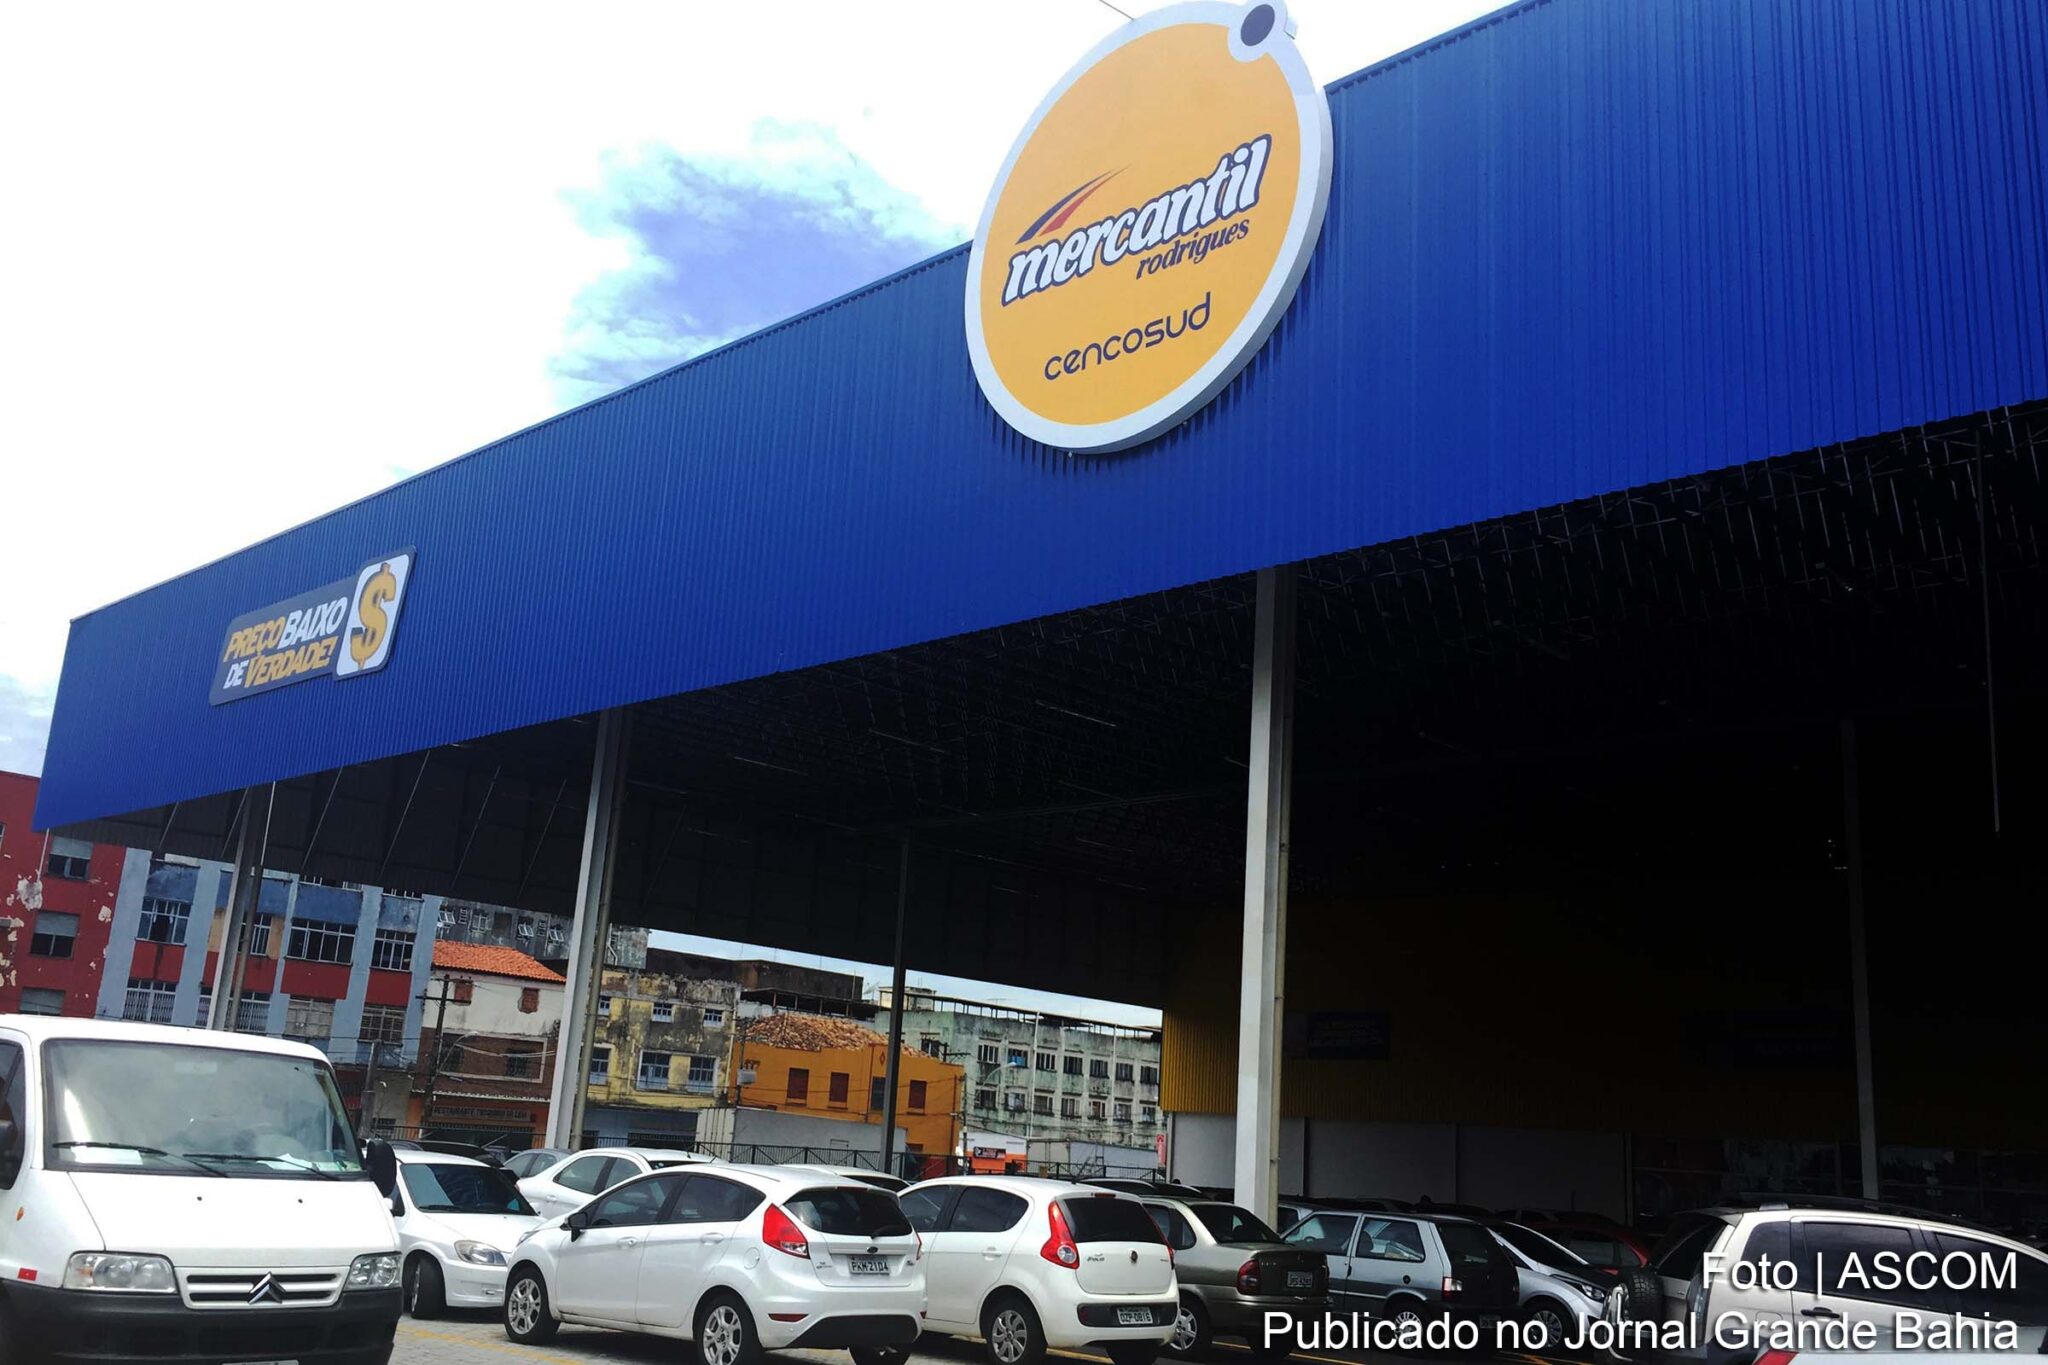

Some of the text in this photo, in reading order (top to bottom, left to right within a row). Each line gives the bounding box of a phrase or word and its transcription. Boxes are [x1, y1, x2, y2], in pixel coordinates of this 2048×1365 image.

[1002, 134, 1271, 306] mercantil
[1135, 219, 1250, 280] rodrigues
[1043, 292, 1212, 380] cencosud
[277, 597, 348, 649] BAIXO
[223, 660, 250, 689] DE
